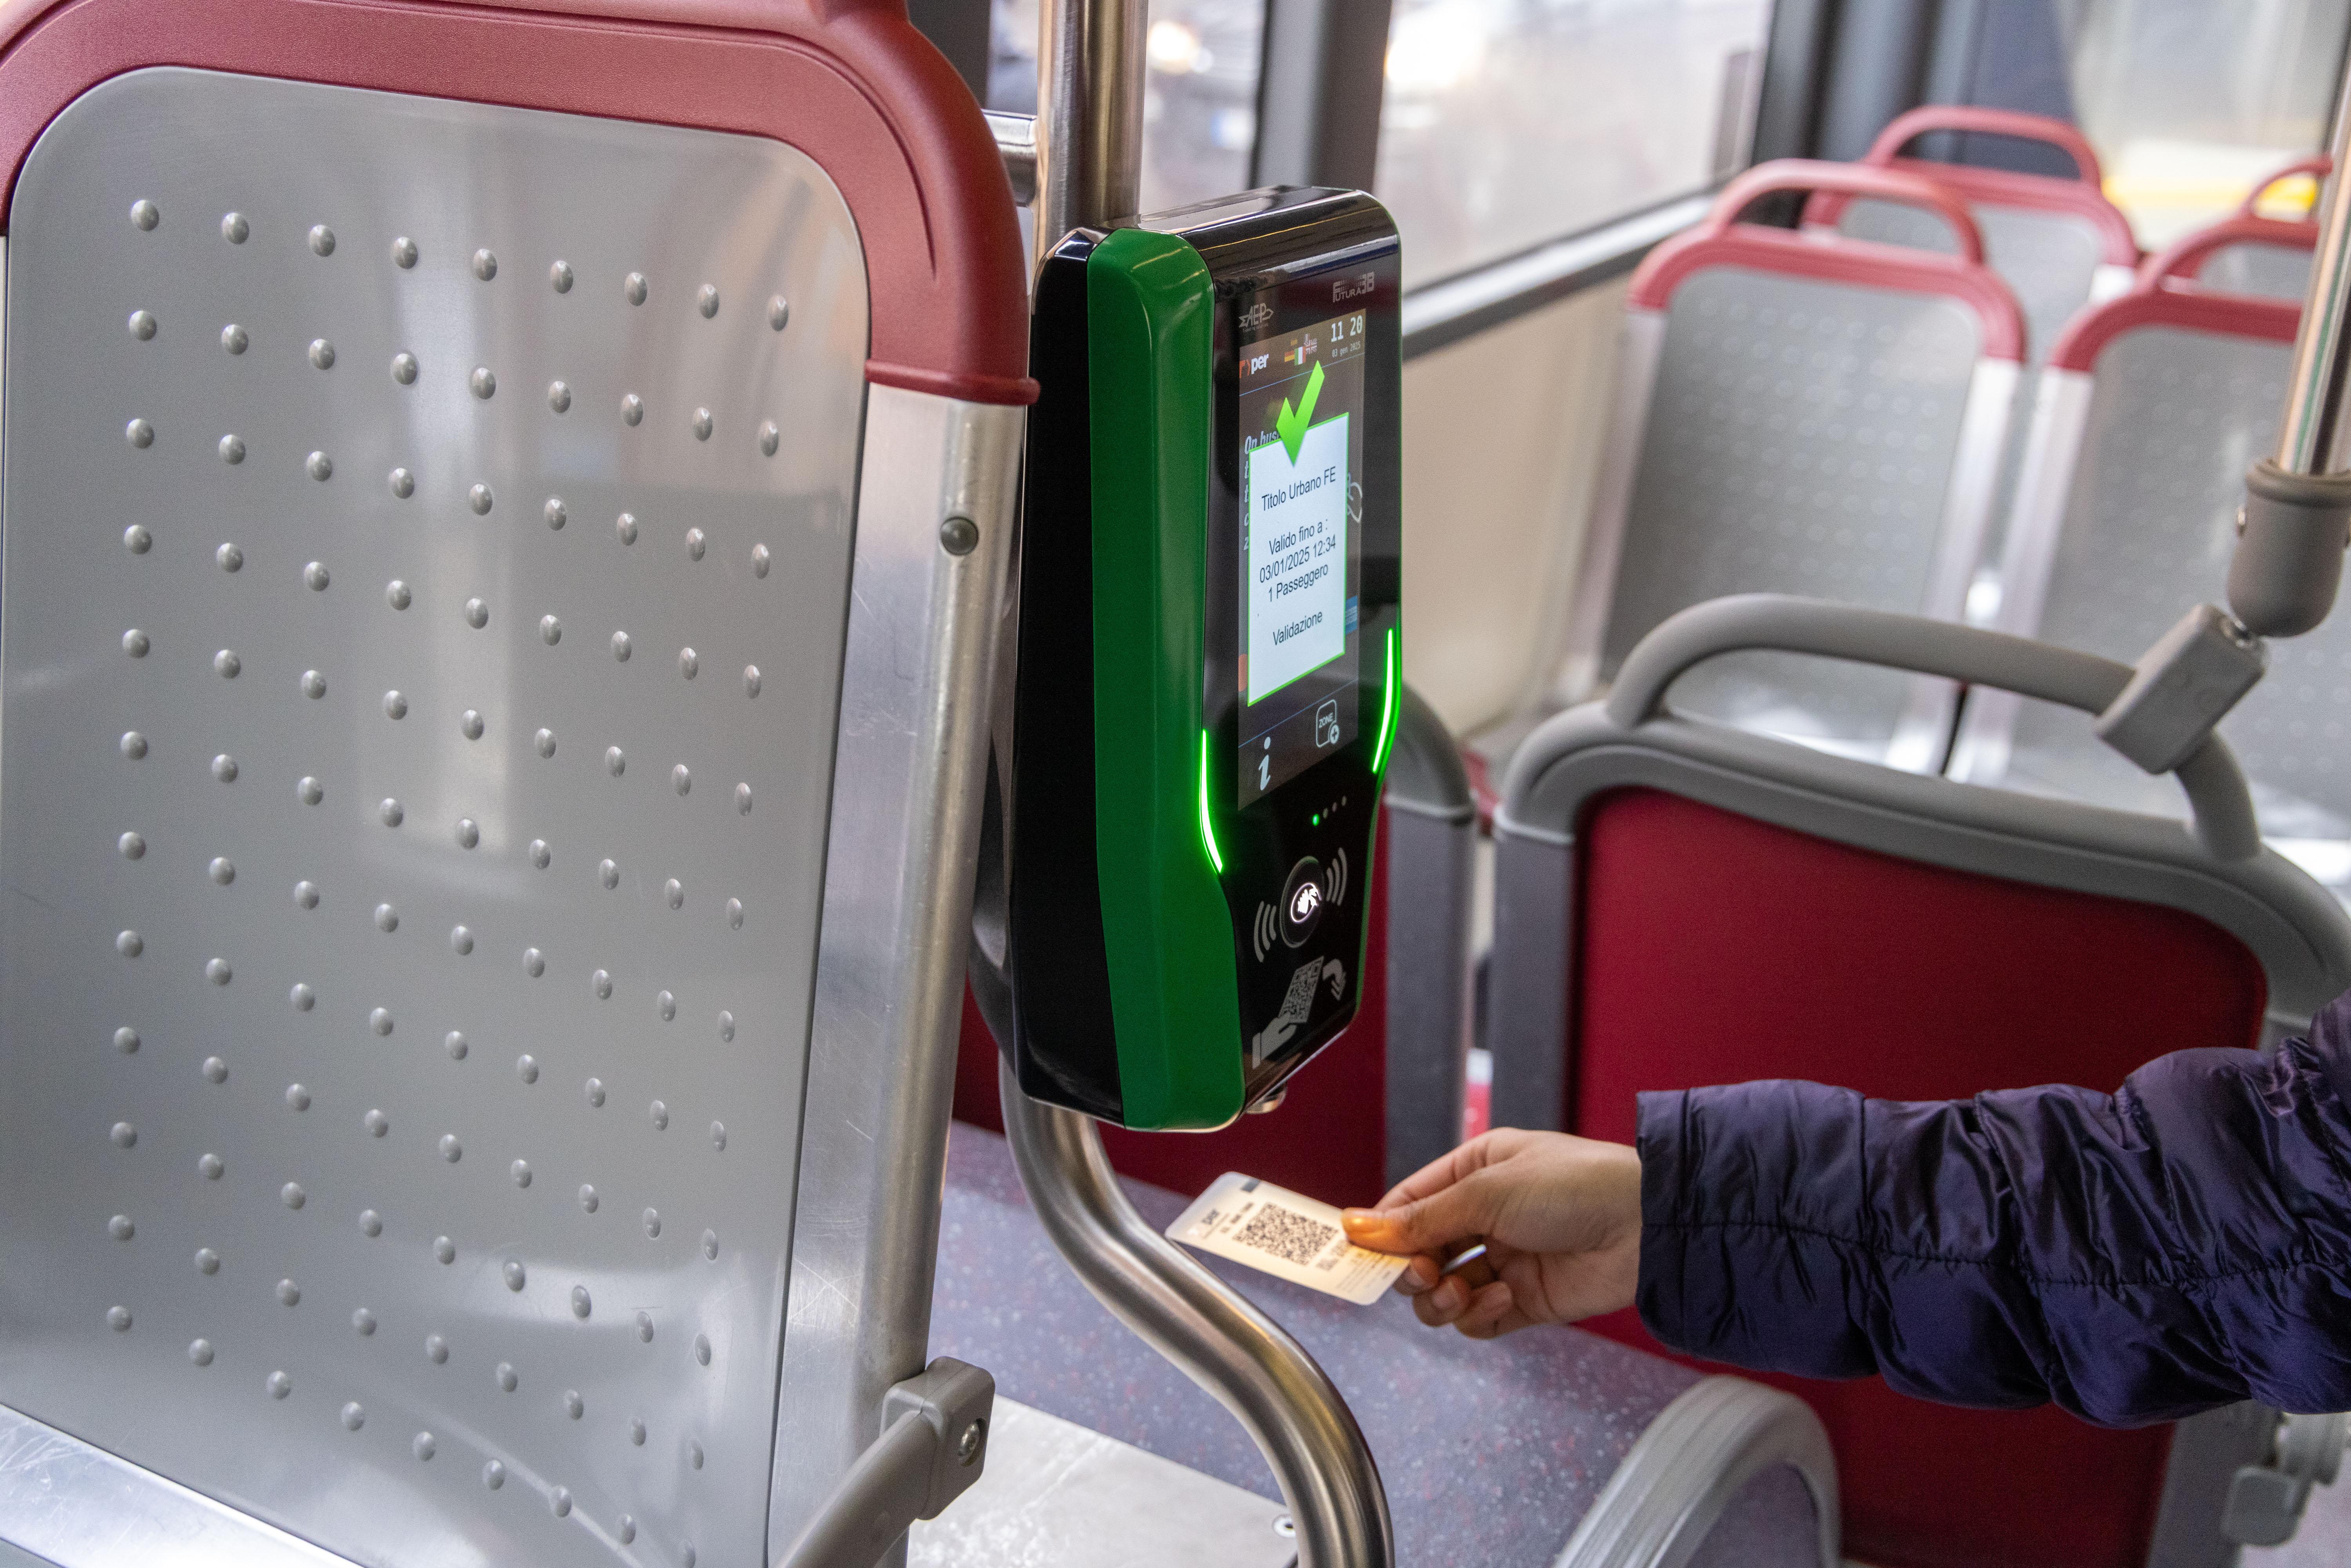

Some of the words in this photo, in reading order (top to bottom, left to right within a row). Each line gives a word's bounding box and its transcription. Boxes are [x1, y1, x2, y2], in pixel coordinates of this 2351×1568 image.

[1331, 321, 1344, 342] 11
[1349, 315, 1363, 336] 20
[1261, 489, 1286, 511] Titolo
[1289, 480, 1321, 500] Urbano
[1324, 466, 1336, 485] FE
[1269, 531, 1296, 555] Valido
[1299, 525, 1315, 542] fino
[1317, 521, 1322, 534] a
[1259, 546, 1310, 583] 03/01/2025
[1313, 534, 1336, 558] 12:34
[1268, 587, 1272, 602] 1
[1276, 564, 1328, 599] Passeggero
[1273, 611, 1322, 646] Validazione
[1319, 712, 1333, 729] ZONE
